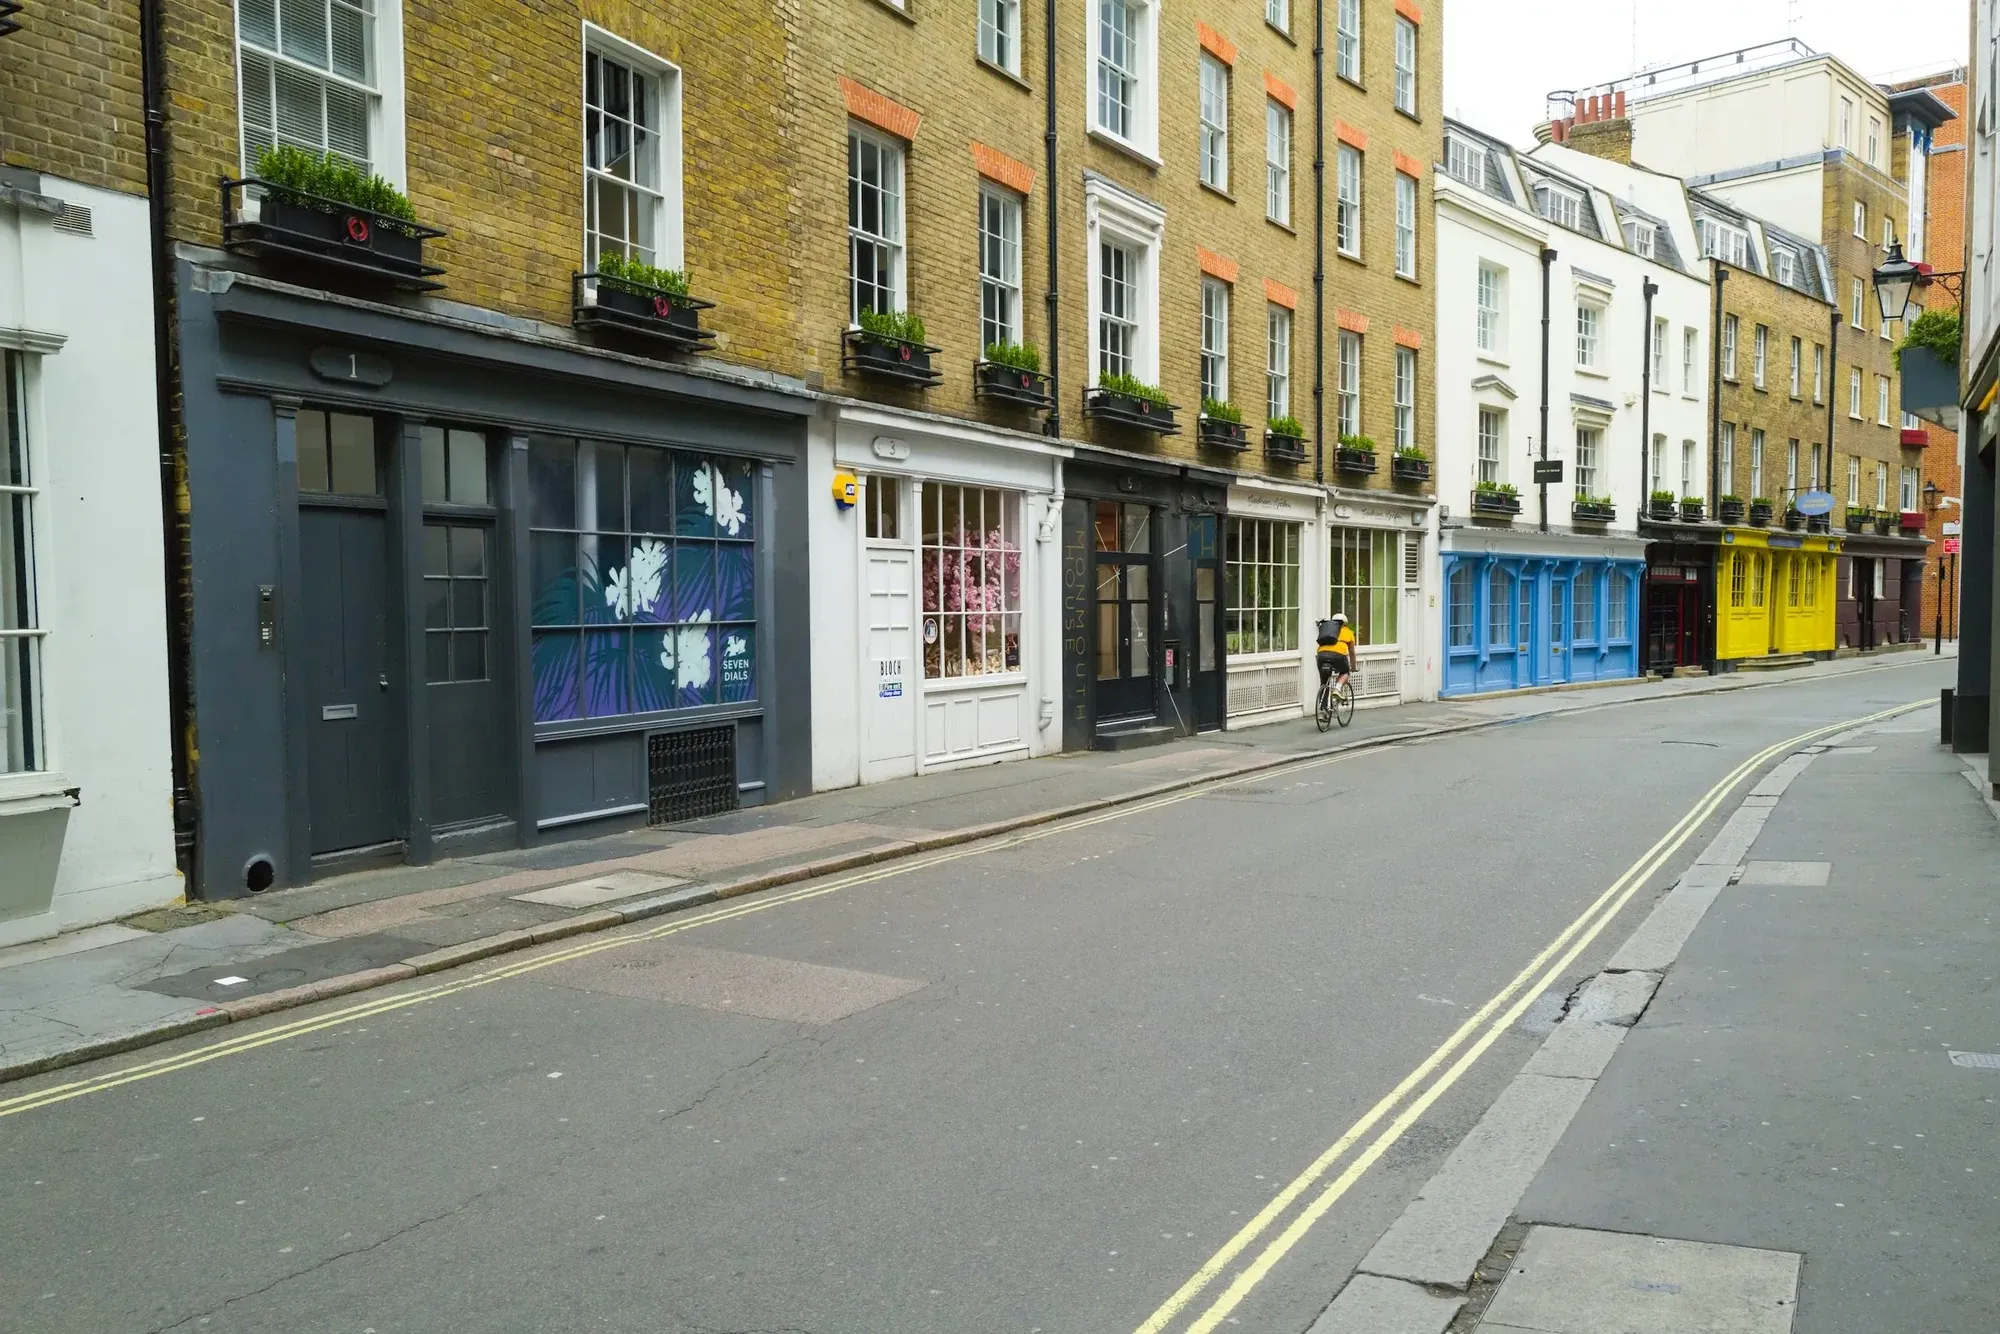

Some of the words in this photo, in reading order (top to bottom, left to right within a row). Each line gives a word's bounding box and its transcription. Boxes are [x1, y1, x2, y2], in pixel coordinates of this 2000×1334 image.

[349, 353, 358, 378] 1
[889, 440, 896, 456] 3
[1065, 545, 1076, 652] HOUSE
[1075, 530, 1086, 720] MONMOUTH
[723, 659, 749, 670] SEVEN
[724, 671, 749, 682] DIALS
